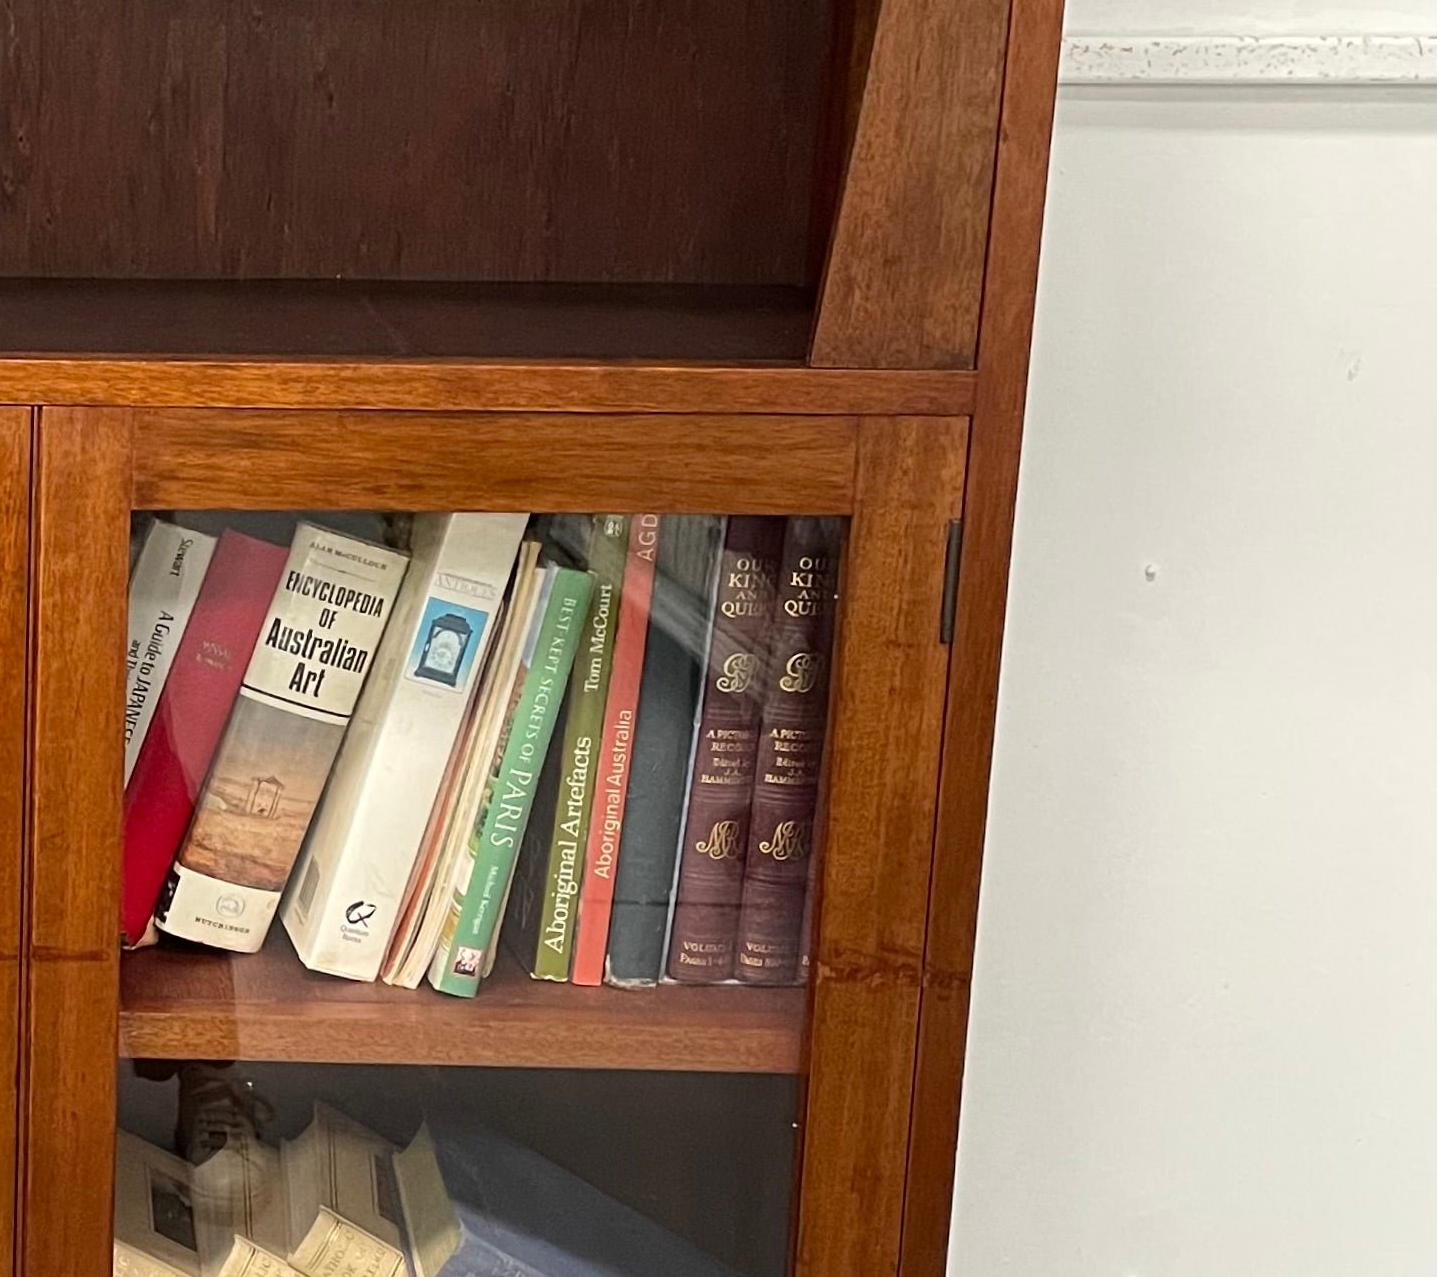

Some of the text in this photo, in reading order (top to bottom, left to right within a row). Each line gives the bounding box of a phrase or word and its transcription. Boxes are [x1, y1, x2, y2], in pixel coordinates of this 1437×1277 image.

[170, 538, 194, 577] Stewart
[310, 541, 334, 554] ALAN
[285, 570, 385, 618] ENCYCLOPEDIA
[160, 610, 174, 622] A
[319, 608, 338, 630] OF
[144, 623, 171, 662] Guide
[265, 617, 368, 674] Australian
[584, 584, 613, 693] Tom McCourt
[139, 659, 155, 677] to
[289, 662, 326, 698] Art
[526, 677, 555, 740] SECRETS
[518, 743, 535, 764] OF
[490, 768, 533, 848] PARIS
[594, 709, 633, 879] Aboriginal Australia
[544, 736, 592, 954] Aboriginal Artefacts
